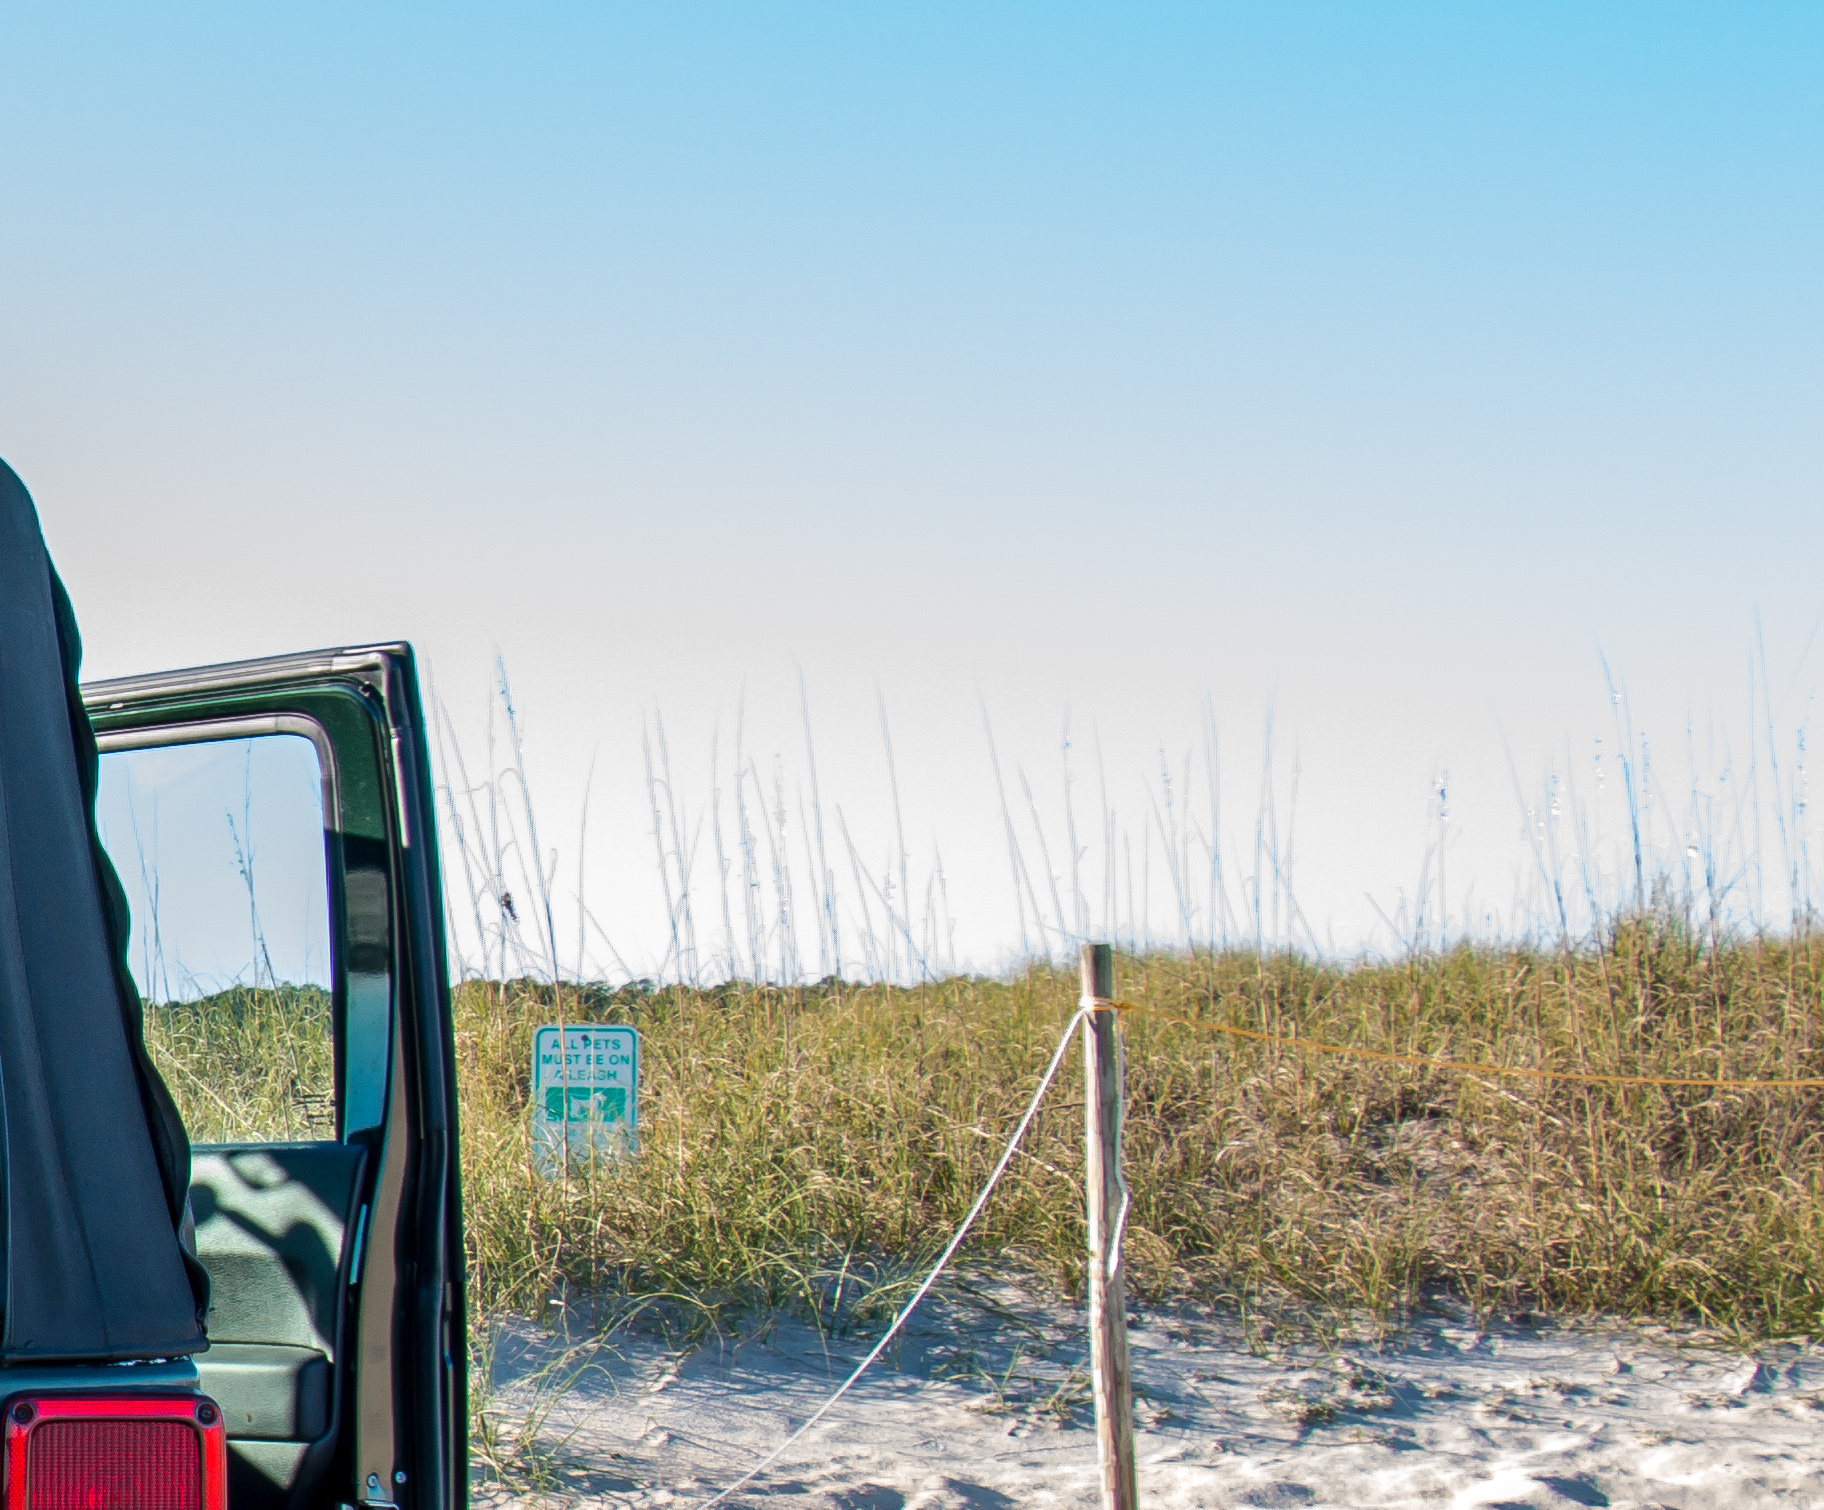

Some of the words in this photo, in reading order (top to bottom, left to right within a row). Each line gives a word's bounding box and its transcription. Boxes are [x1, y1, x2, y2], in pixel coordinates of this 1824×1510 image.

[583, 1038, 621, 1050] PETS
[541, 1054, 581, 1065] MUST
[586, 1054, 604, 1065] BE
[609, 1054, 630, 1065] ON
